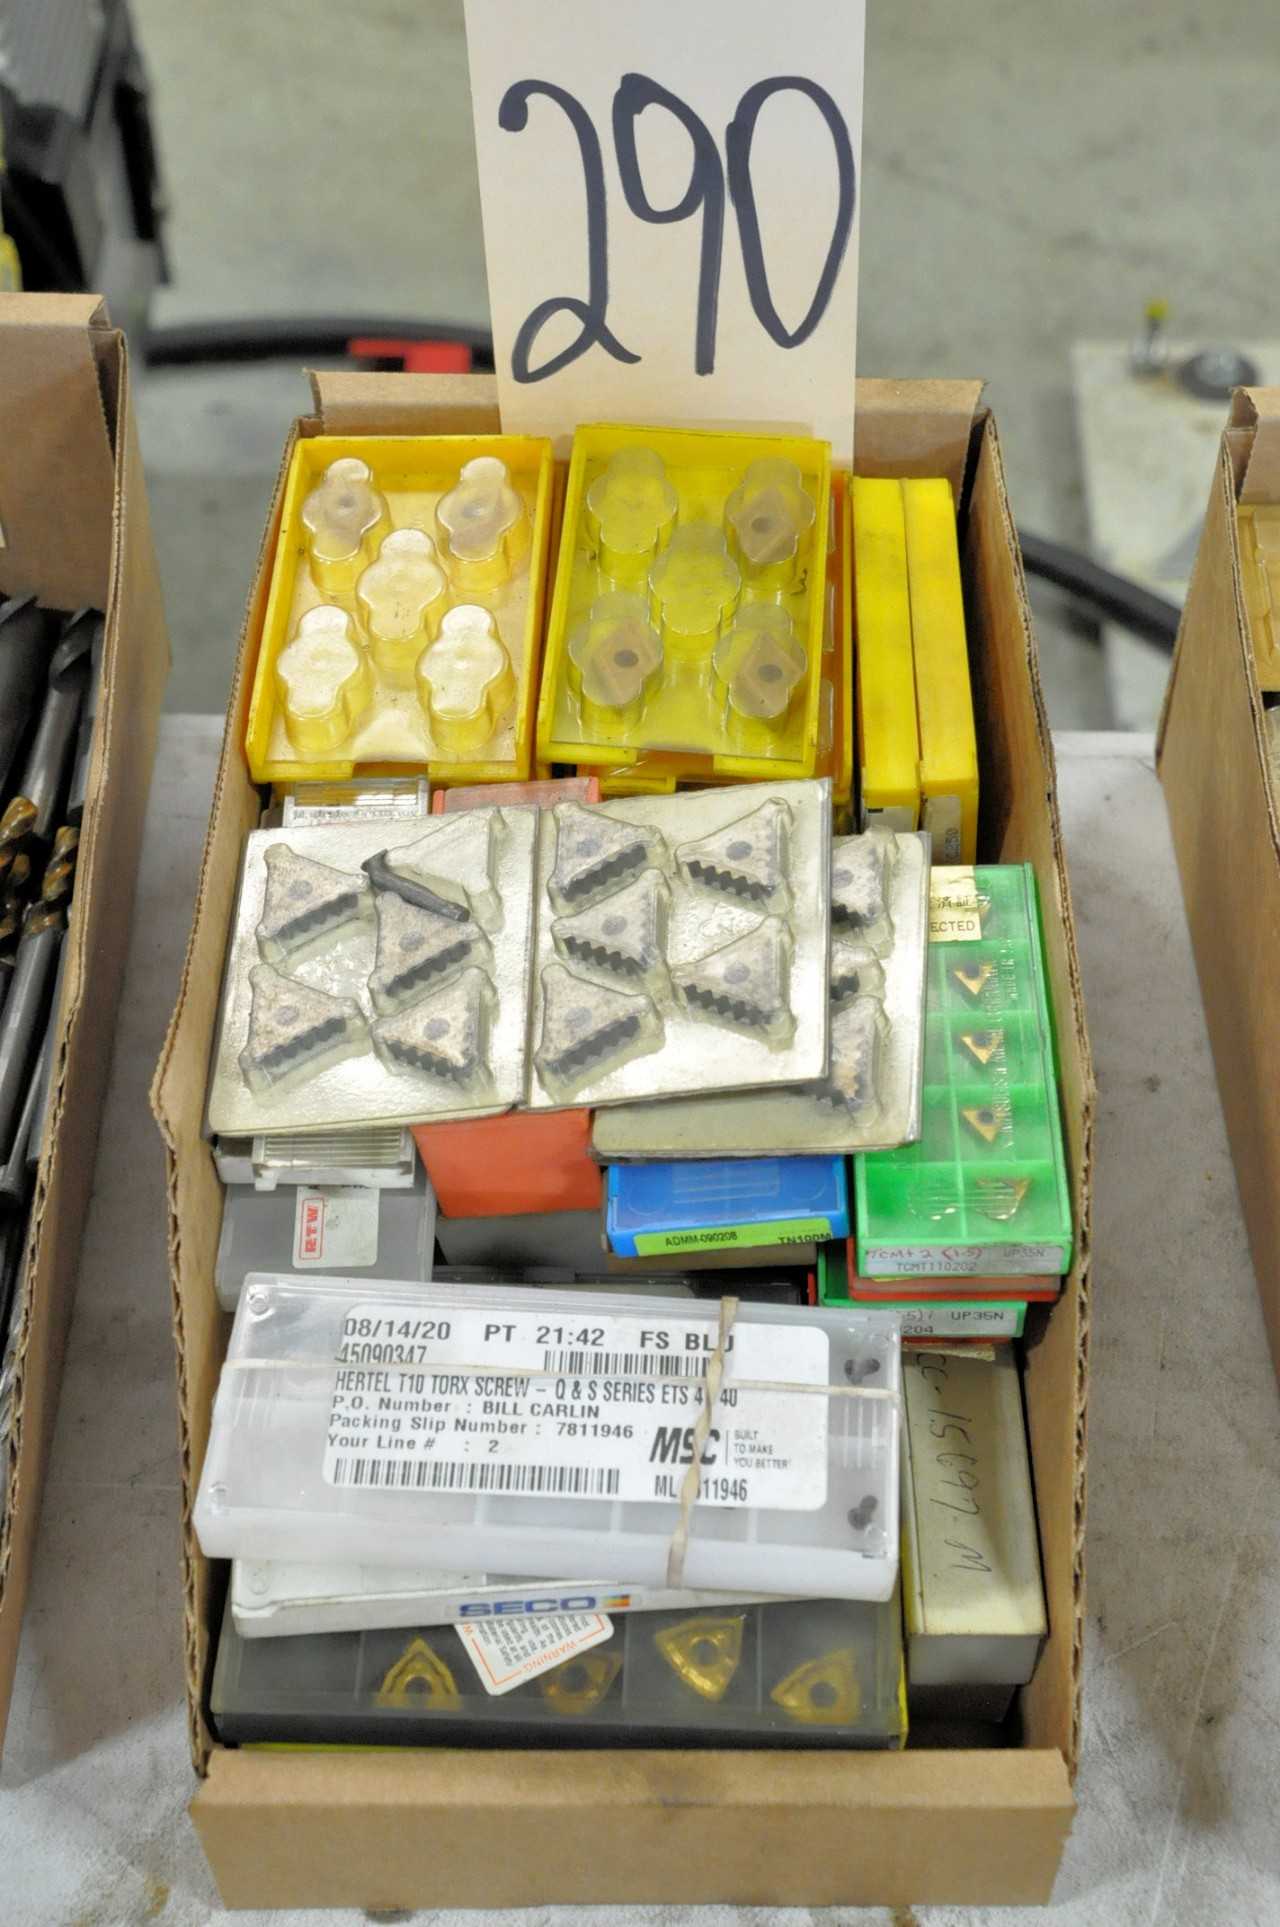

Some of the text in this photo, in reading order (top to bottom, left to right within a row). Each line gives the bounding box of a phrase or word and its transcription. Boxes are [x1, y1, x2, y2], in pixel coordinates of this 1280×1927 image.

[499, 73, 855, 383] 290
[930, 920, 976, 932] ECTED
[344, 1318, 450, 1340] 08/14/20
[484, 1324, 517, 1342] PT
[536, 1326, 605, 1346] 21:42
[640, 1331, 669, 1349] FS
[903, 1325, 934, 1334] 204
[336, 1371, 391, 1392] HERTEL
[400, 1373, 424, 1394] T10
[432, 1375, 469, 1395] TORX
[474, 1376, 530, 1398] SCREW
[555, 1378, 566, 1400] Q
[571, 1380, 582, 1400] &
[588, 1380, 597, 1401] S
[603, 1380, 655, 1404] SERIES
[662, 1385, 688, 1405] ETS
[332, 1395, 369, 1410] P.O.
[378, 1397, 451, 1412] Number
[483, 1401, 523, 1415] BILL
[530, 1402, 599, 1418] CARLIN
[329, 1413, 401, 1431] Packing
[411, 1416, 446, 1433] Slip
[454, 1418, 527, 1434] Number
[557, 1422, 633, 1438] 7811946
[734, 1430, 758, 1440] BUILT
[328, 1434, 368, 1447] Your
[377, 1435, 416, 1449] Line
[424, 1437, 435, 1449] #
[488, 1440, 499, 1453] 2
[649, 1427, 720, 1465] MSC
[734, 1443, 773, 1455] TO MAKE
[733, 1457, 788, 1469] YOU BETTER
[655, 1475, 748, 1501] ML11946
[459, 1597, 596, 1617] SECO
